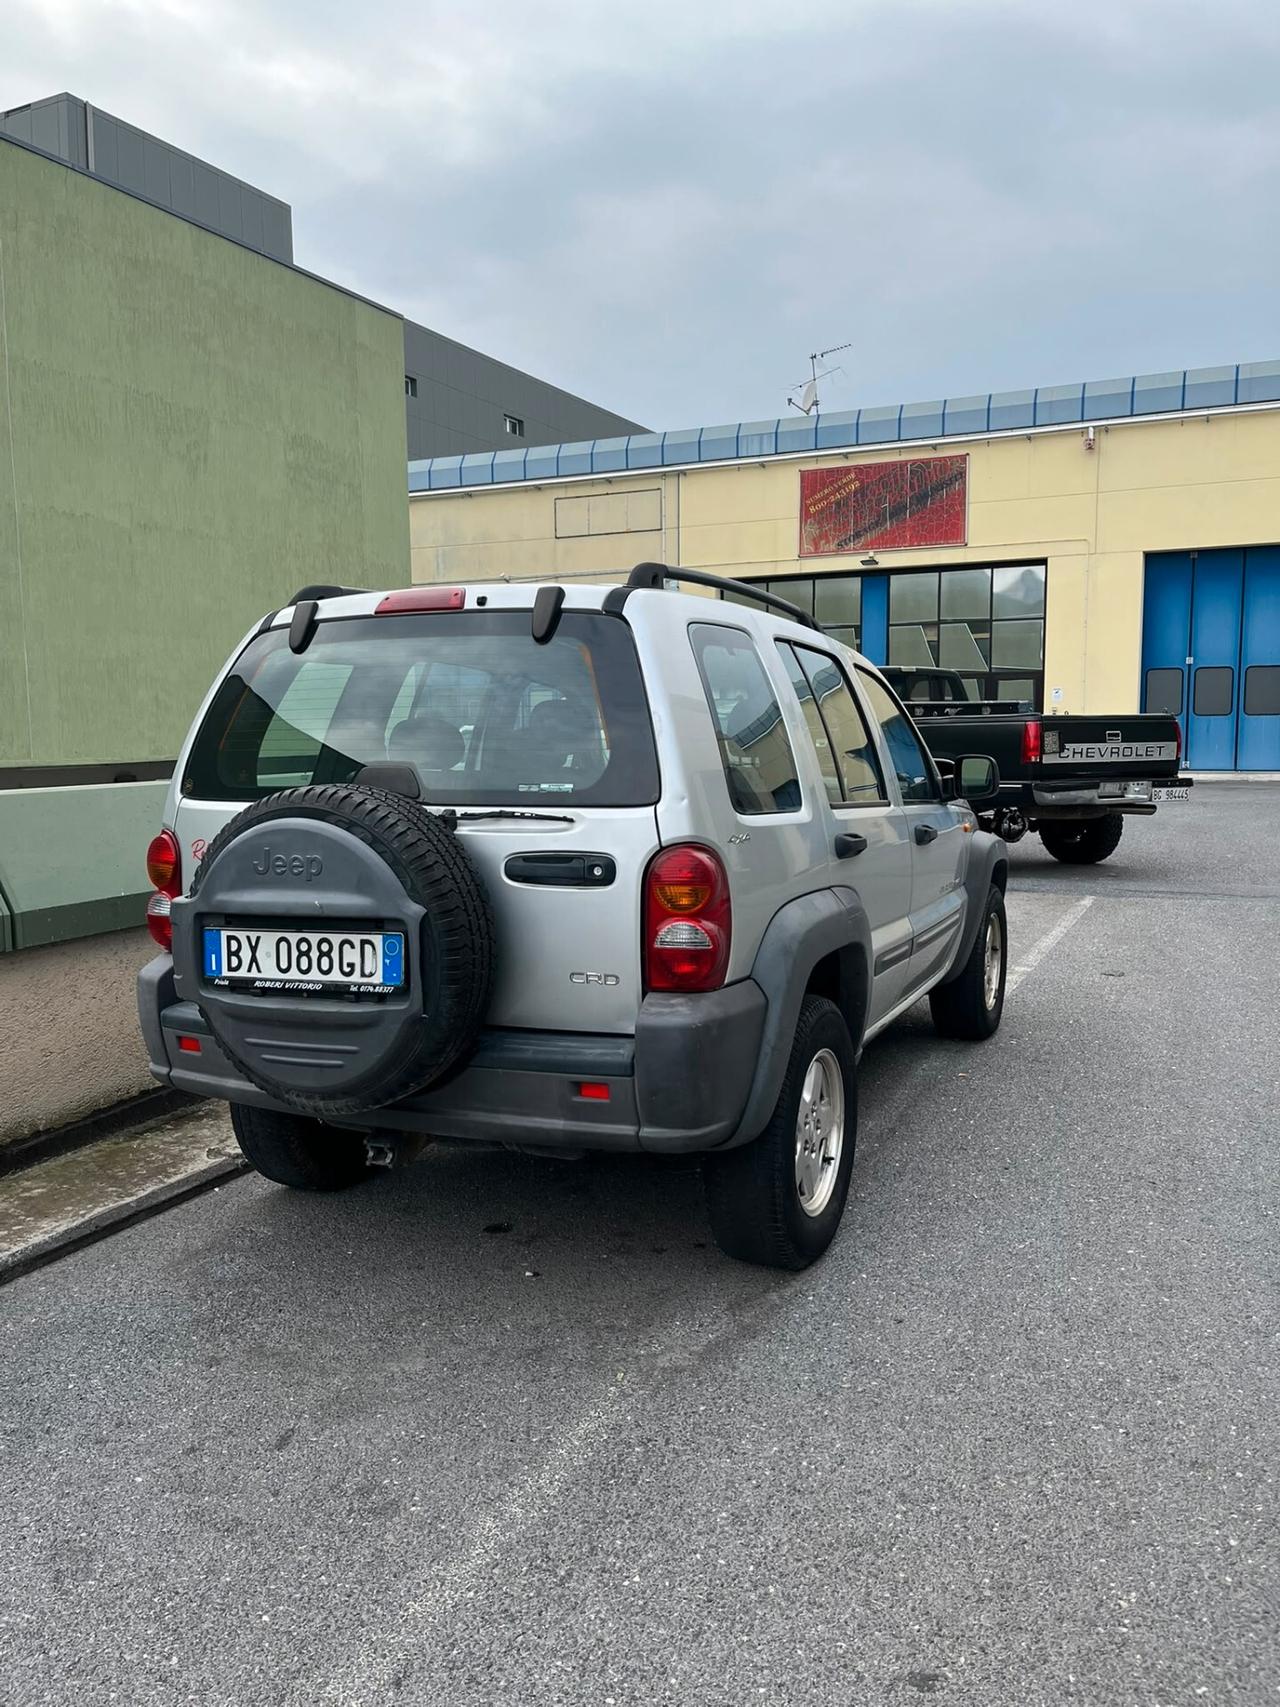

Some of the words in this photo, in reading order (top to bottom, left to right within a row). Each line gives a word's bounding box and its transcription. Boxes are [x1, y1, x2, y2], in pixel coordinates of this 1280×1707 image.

[1058, 745, 1166, 759] CHEVROLET
[253, 847, 323, 881] Jeep
[226, 934, 262, 974] BX
[275, 936, 378, 978] 088GD
[284, 981, 323, 991] VITTORIO
[569, 971, 620, 987] CRD
